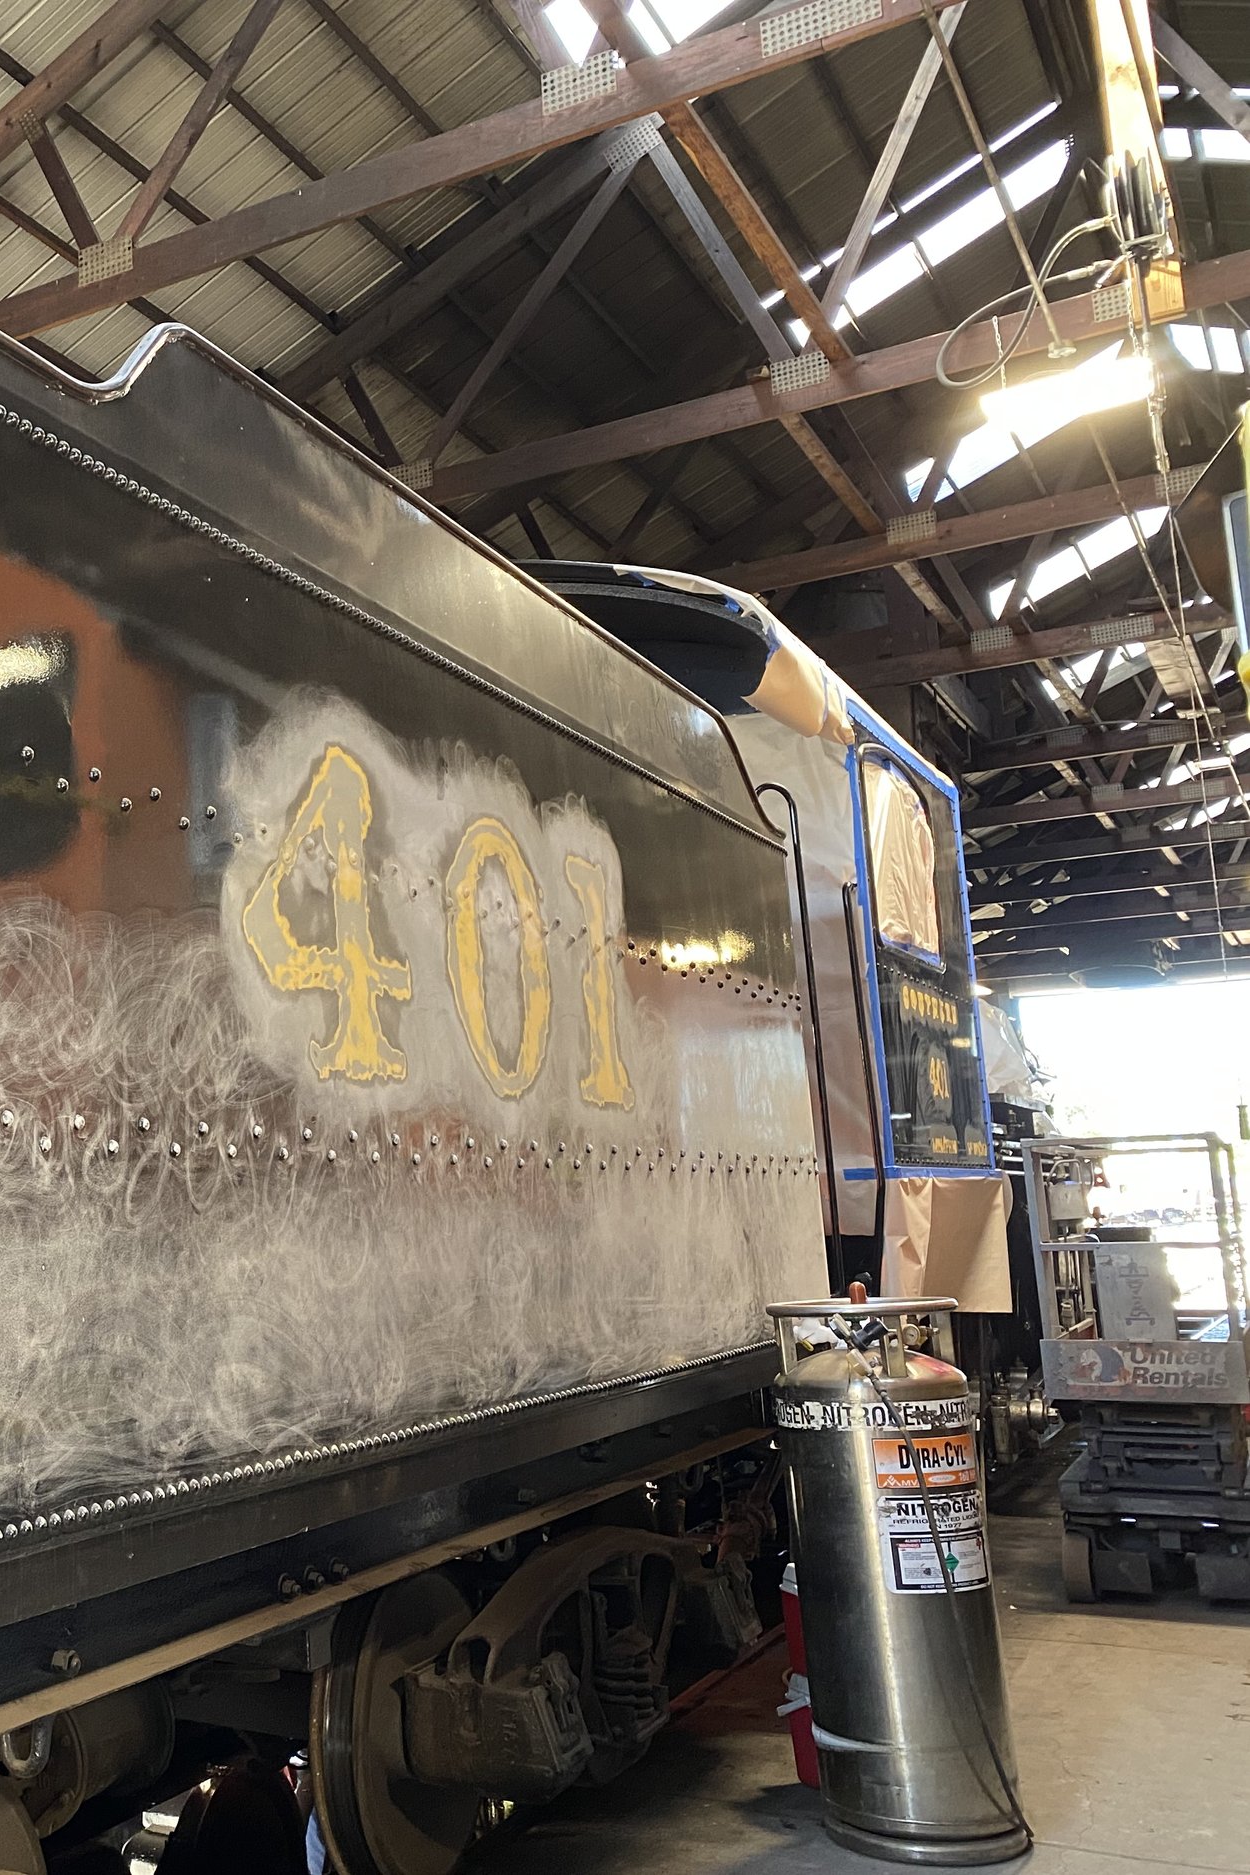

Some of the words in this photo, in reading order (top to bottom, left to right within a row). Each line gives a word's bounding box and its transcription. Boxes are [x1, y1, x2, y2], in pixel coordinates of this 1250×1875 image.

[243, 746, 635, 1112] 401
[1130, 1345, 1217, 1365] United
[1132, 1366, 1228, 1386] Rentals
